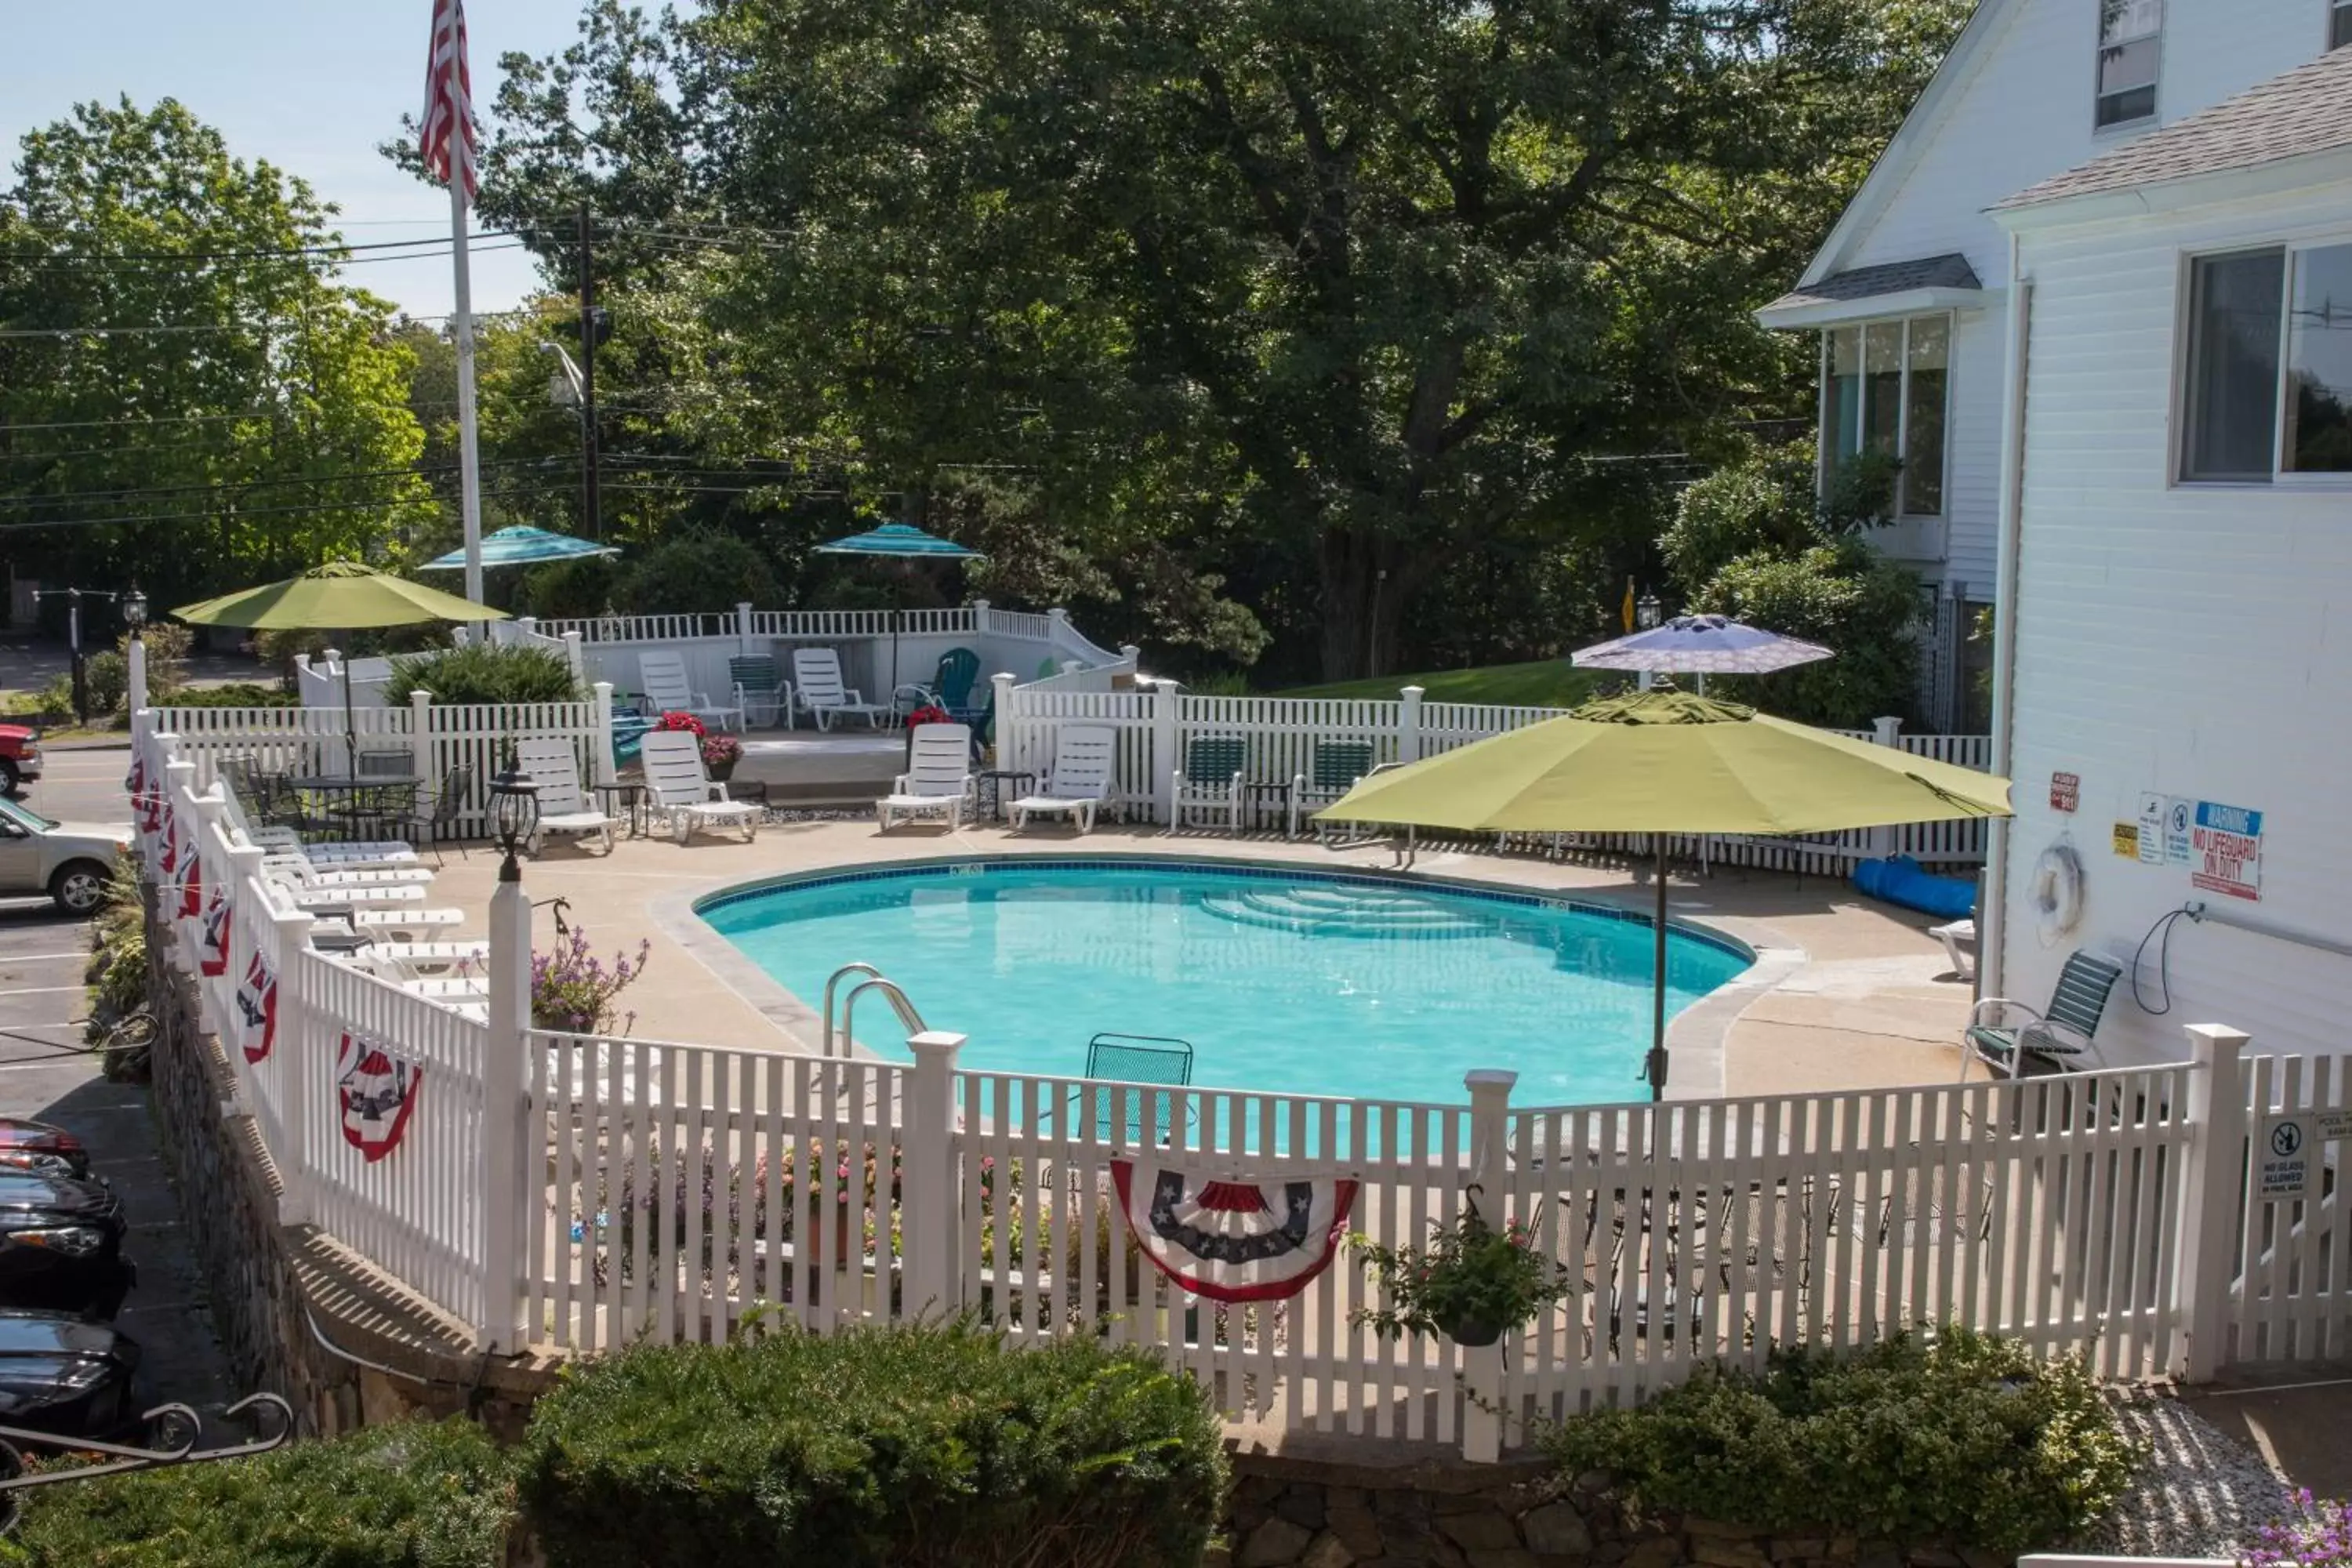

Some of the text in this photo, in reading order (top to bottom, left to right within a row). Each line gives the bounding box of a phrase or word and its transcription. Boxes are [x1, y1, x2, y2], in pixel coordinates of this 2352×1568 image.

[2207, 804, 2250, 832] WARNING
[2193, 828, 2256, 861] NO LIFEGUARD
[2204, 853, 2243, 881] ON DUTY
[2264, 1161, 2303, 1172] NO GLASS
[2264, 1172, 2303, 1183] ALLOWED
